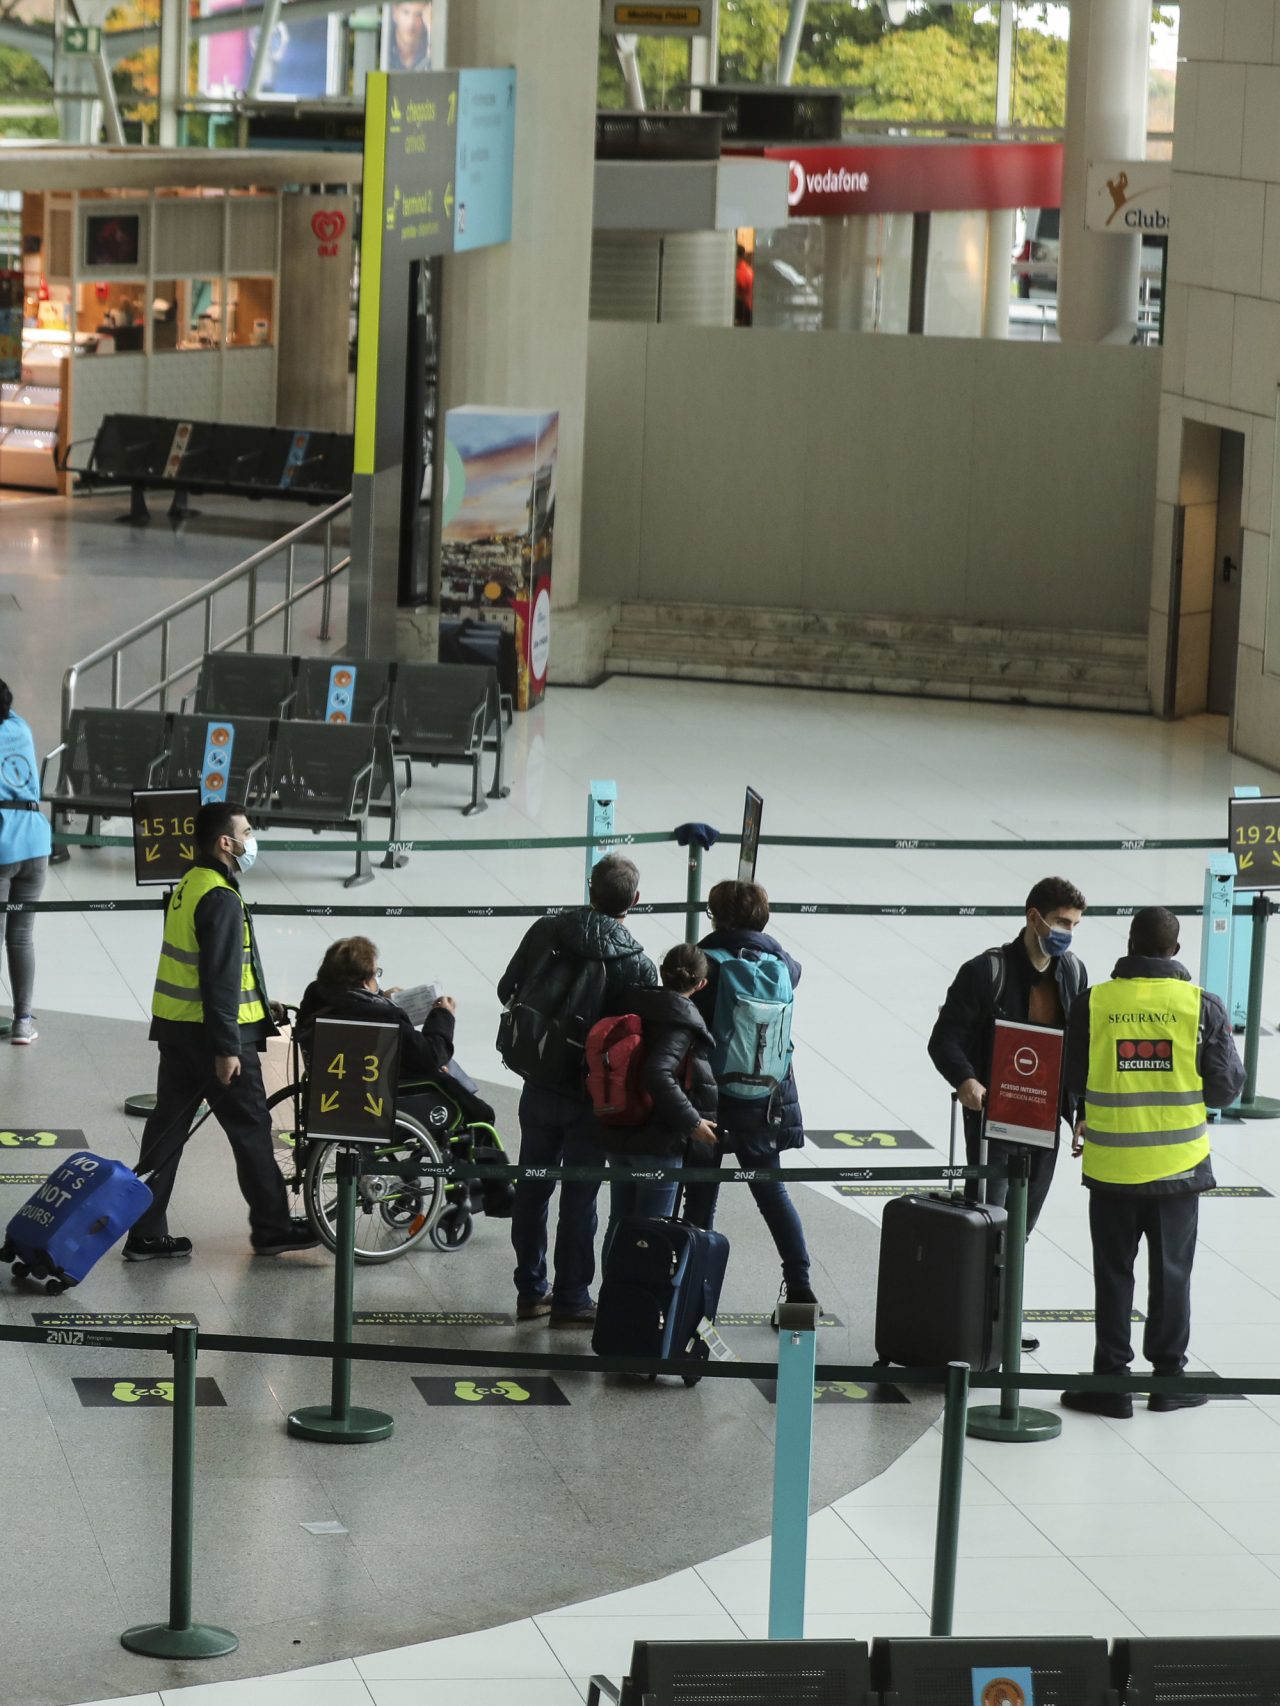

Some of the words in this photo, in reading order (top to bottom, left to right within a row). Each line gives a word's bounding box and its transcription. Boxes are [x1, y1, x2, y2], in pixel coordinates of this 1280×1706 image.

[806, 167, 869, 193] vodafone
[140, 818, 165, 837] 15
[170, 816, 195, 836] 16
[1235, 825, 1260, 845] 19
[1108, 1013, 1177, 1025] SEGURANÇA
[327, 1053, 347, 1079] 4
[362, 1055, 380, 1082] 3
[1119, 1060, 1171, 1069] SECURITAS
[1000, 1082, 1020, 1092] ACESSO
[1020, 1086, 1048, 1096] INTERDITO
[70, 1156, 100, 1178] NO,
[37, 1184, 72, 1208] NOT
[18, 1204, 56, 1227] YOURS!
[134, 1388, 164, 1397] 02
[475, 1387, 507, 1395] 03
